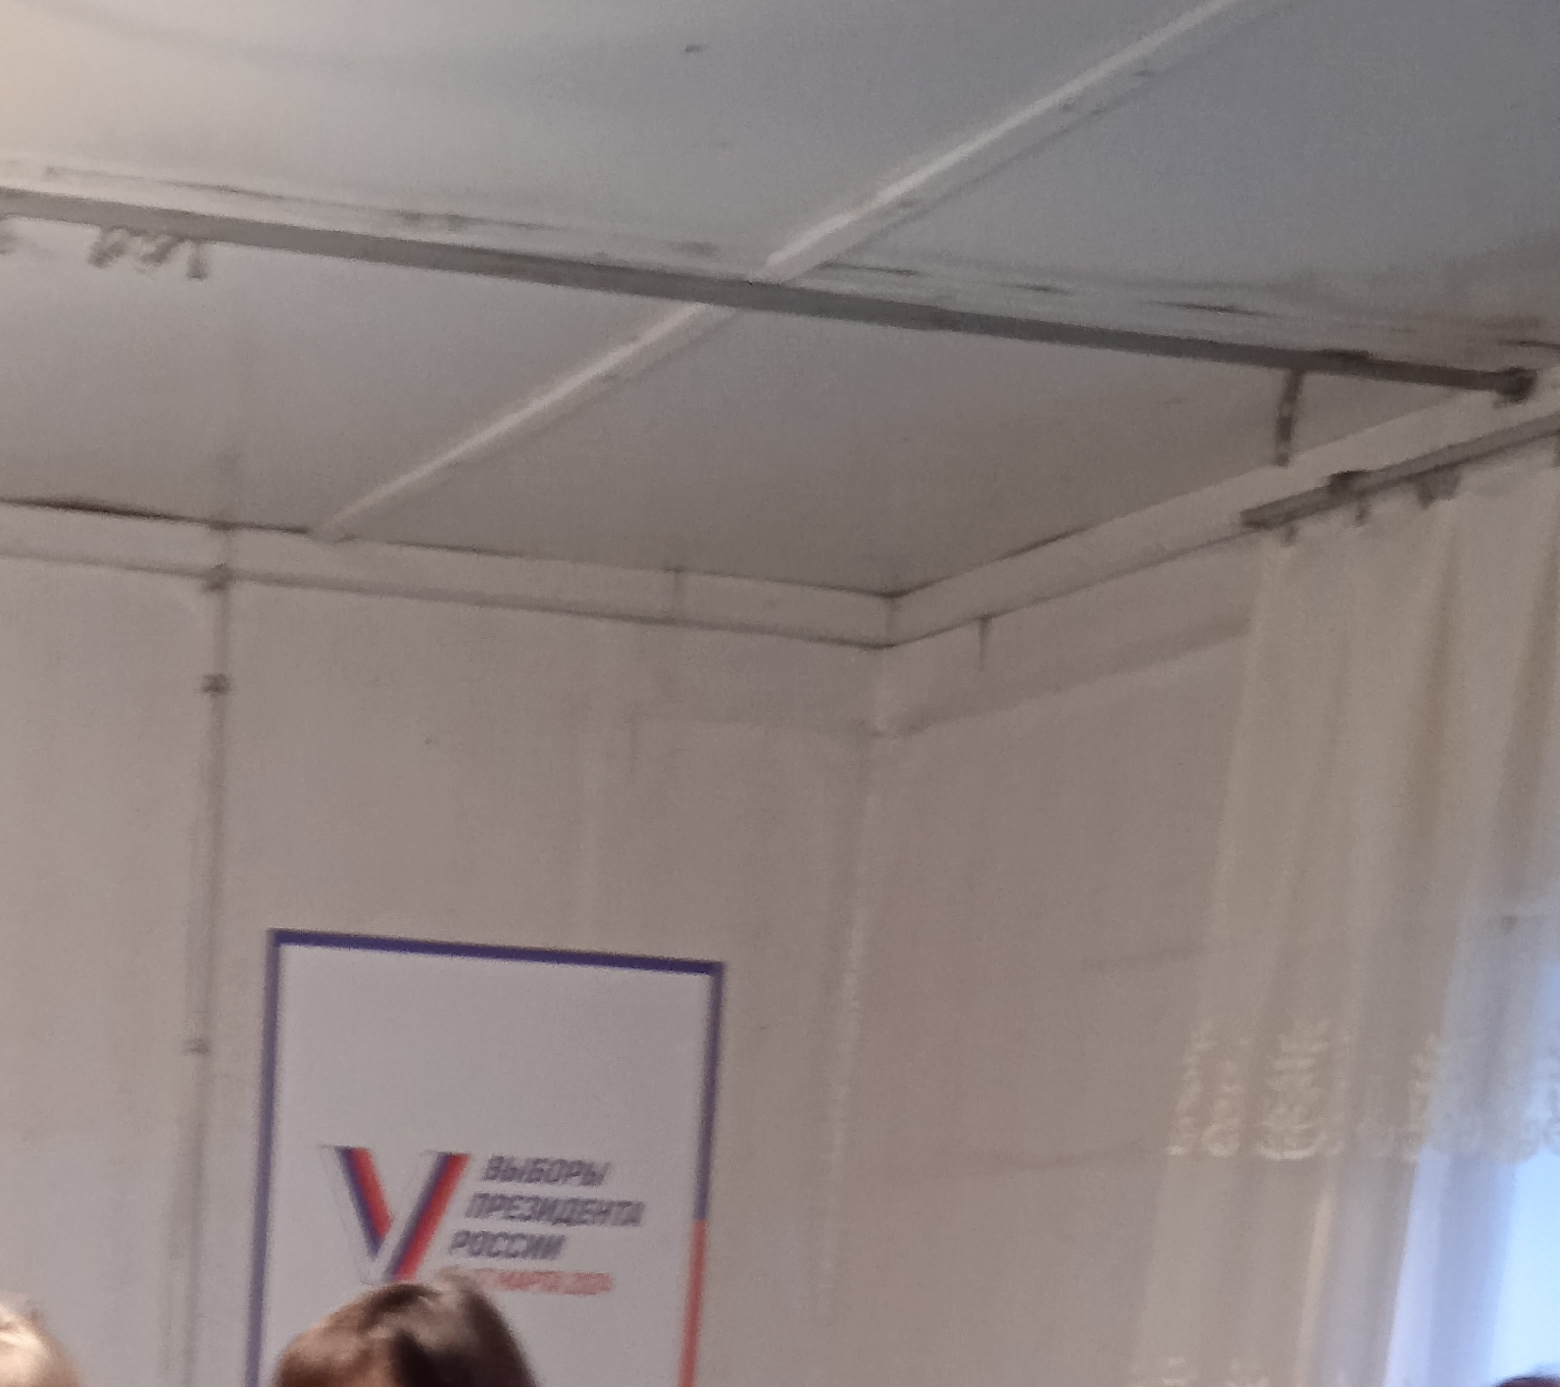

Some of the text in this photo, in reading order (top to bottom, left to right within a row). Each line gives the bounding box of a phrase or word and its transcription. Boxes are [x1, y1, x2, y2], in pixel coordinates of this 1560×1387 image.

[481, 1155, 611, 1187] ВЫБОРЫ
[464, 1192, 645, 1227] ПРЕЗИДЕНТА
[449, 1229, 566, 1260] РОССИИ
